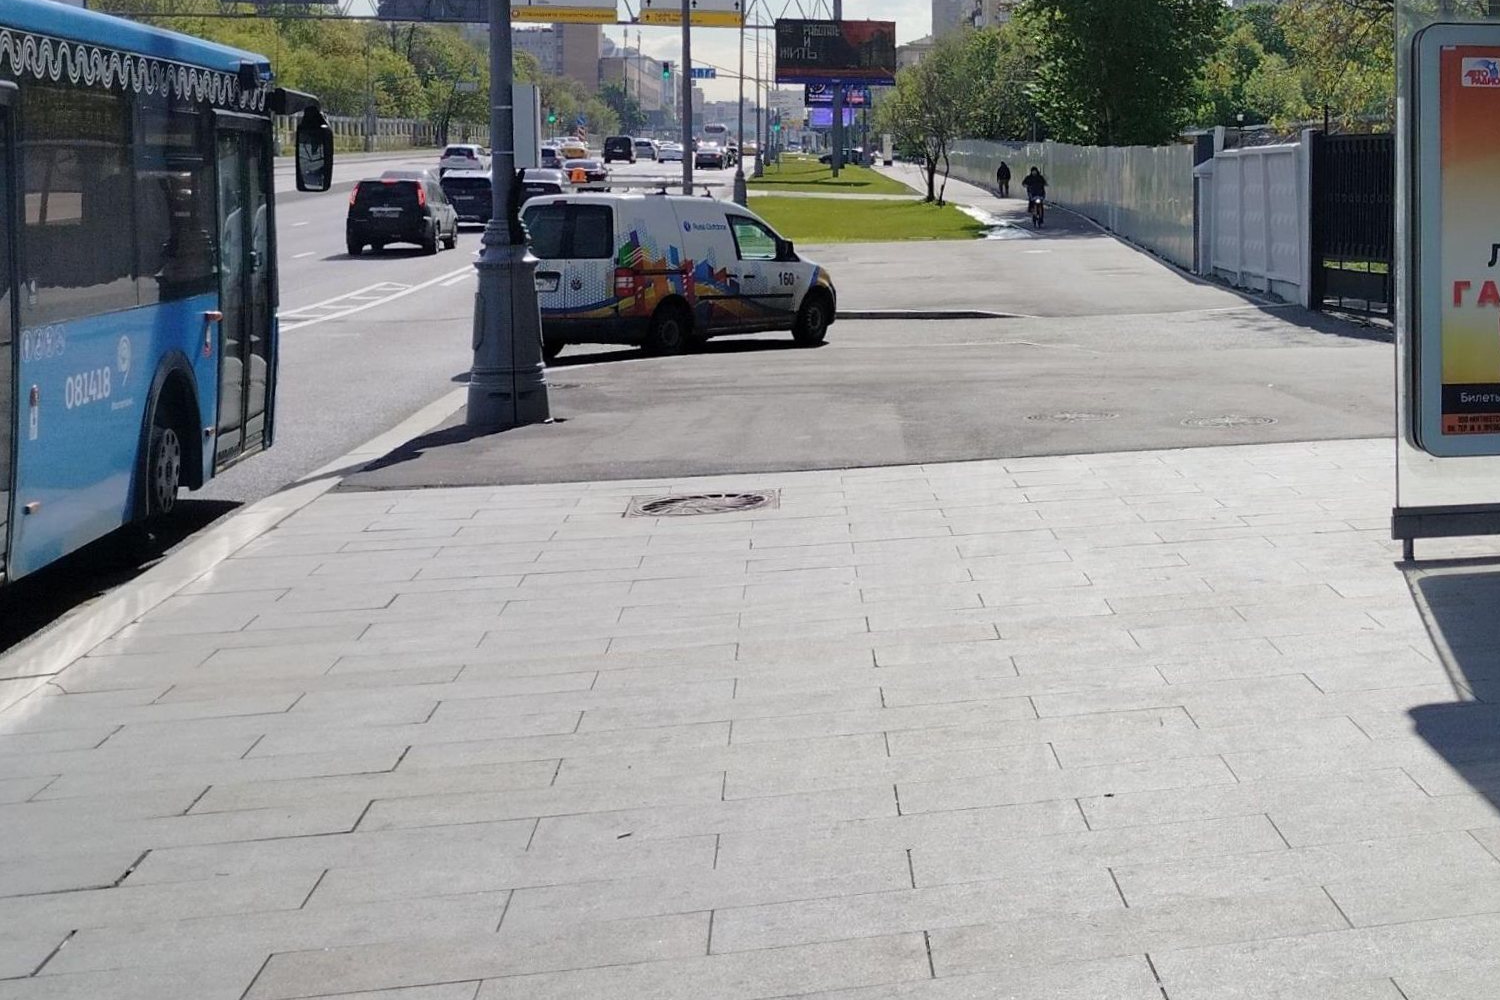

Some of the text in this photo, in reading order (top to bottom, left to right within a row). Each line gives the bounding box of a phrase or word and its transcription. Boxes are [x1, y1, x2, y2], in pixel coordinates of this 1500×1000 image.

[803, 36, 811, 47] И
[778, 271, 795, 286] 160
[65, 366, 111, 410] 081418
